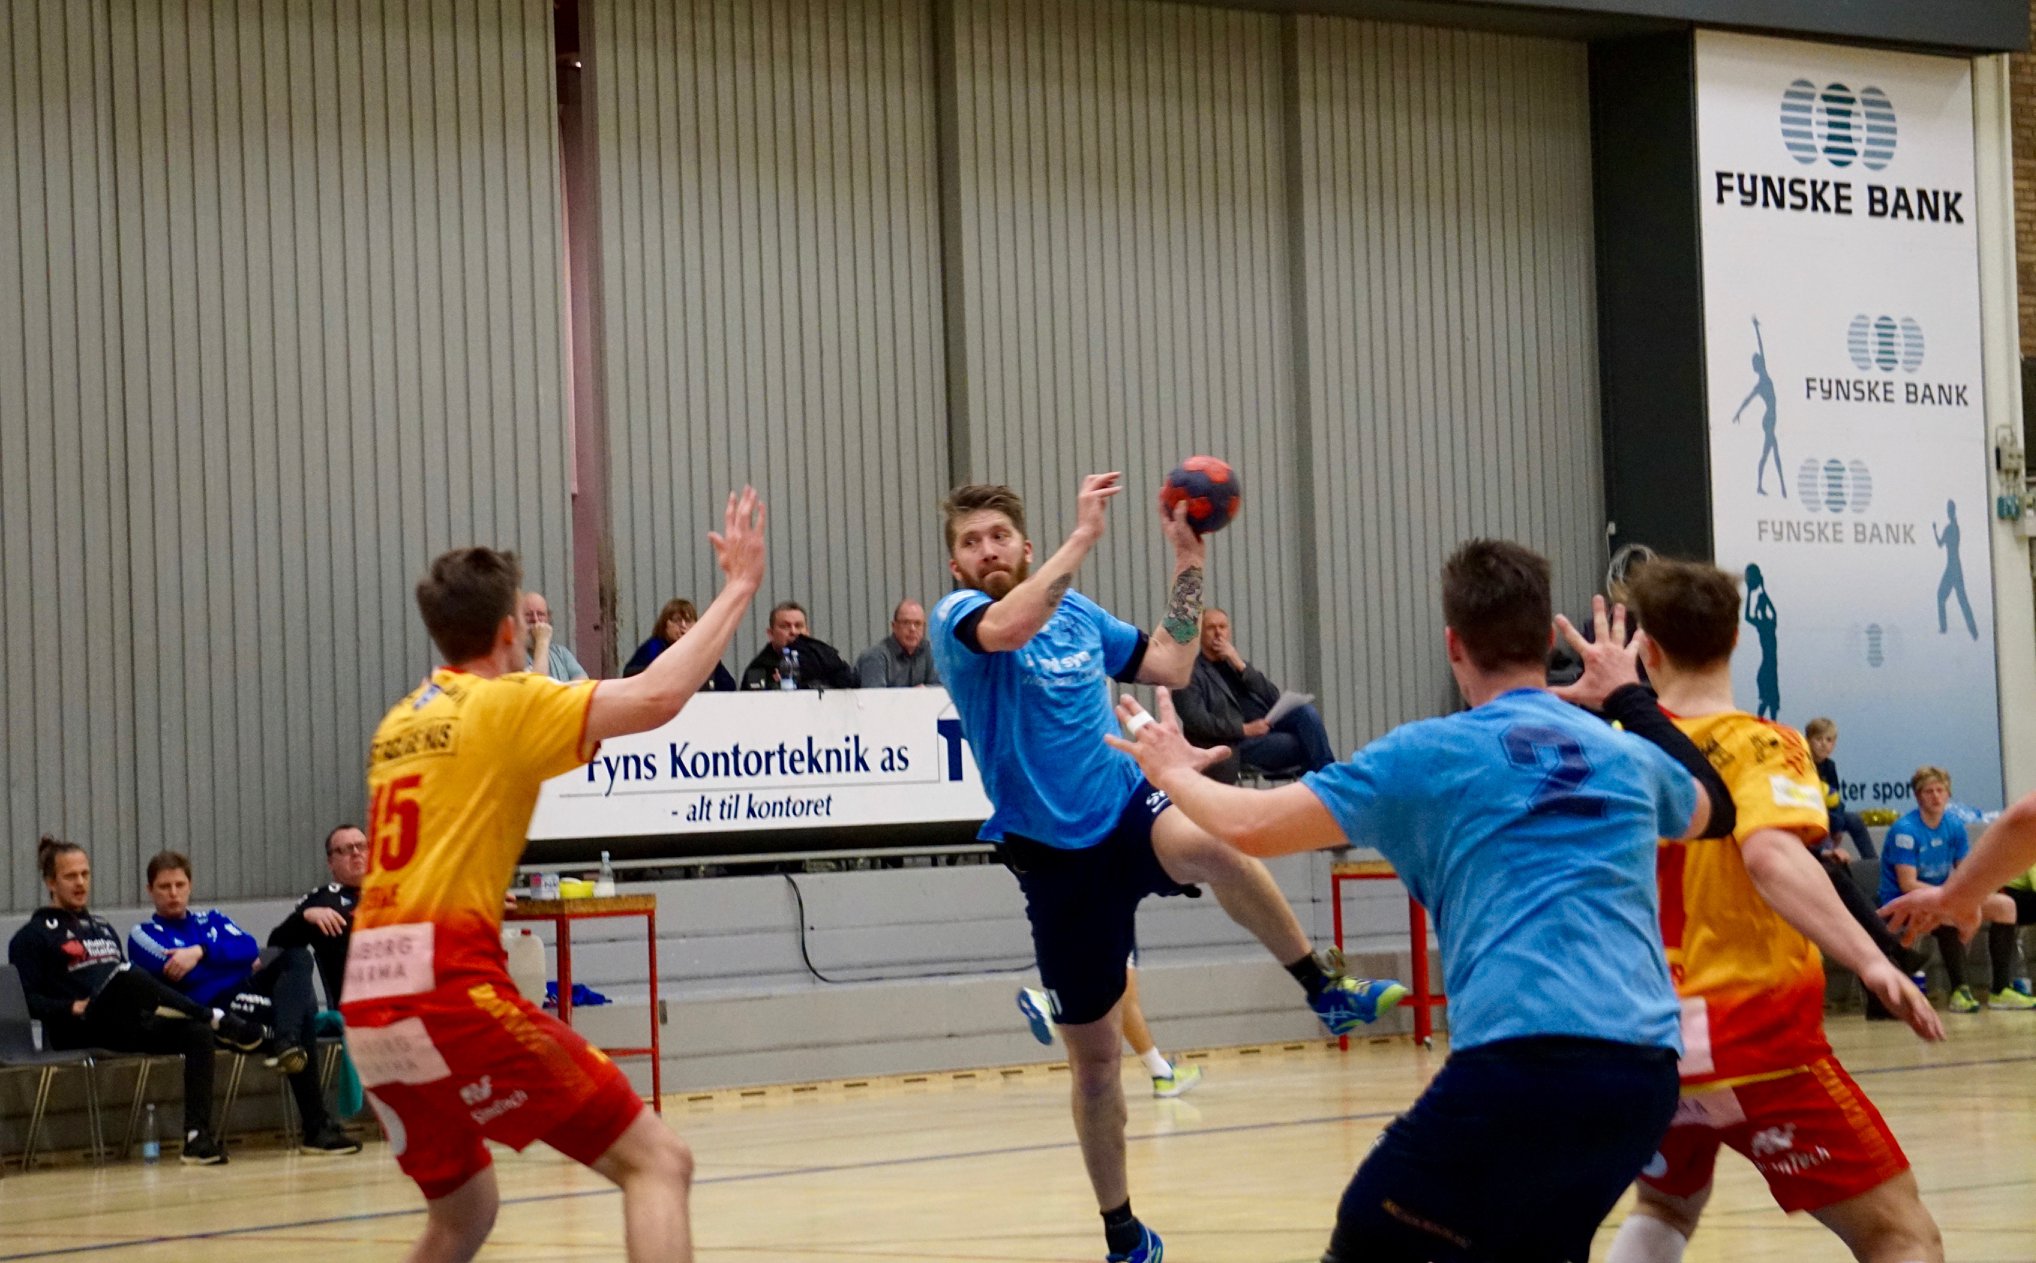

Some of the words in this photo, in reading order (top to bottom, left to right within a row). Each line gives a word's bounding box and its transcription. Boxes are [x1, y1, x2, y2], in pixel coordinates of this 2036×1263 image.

[1715, 170, 1853, 215] FYNSKE
[1867, 184, 1965, 224] BANK
[1805, 377, 1895, 404] FYNSKE
[1905, 382, 1969, 407] BANK
[1757, 520, 1844, 544] FYNSKE
[1853, 522, 1916, 545] BANK
[669, 734, 871, 780] Kontorteknik
[880, 745, 910, 773] as
[1500, 724, 1607, 818] 2
[685, 794, 713, 822] alt
[719, 793, 741, 821] til
[745, 793, 833, 820] kontoret
[1872, 781, 1912, 804] spor
[366, 774, 422, 874] 15
